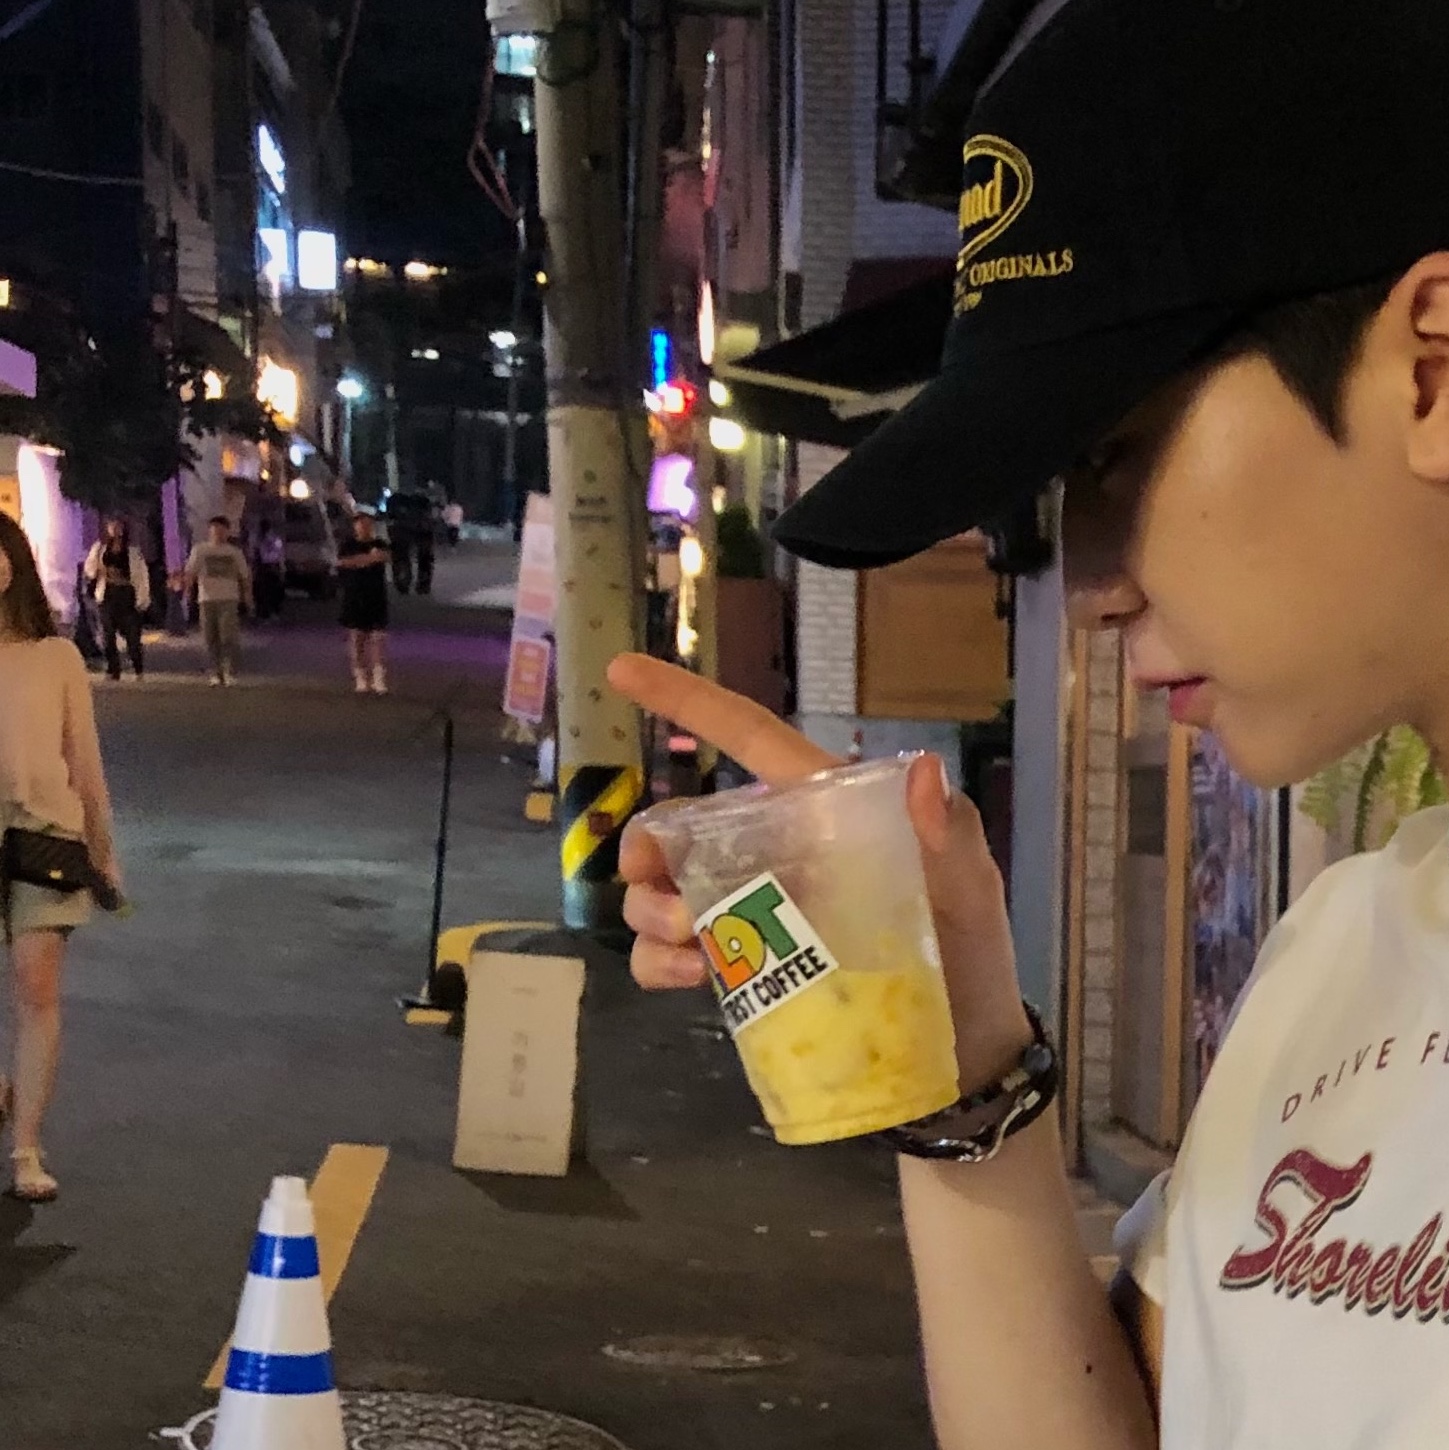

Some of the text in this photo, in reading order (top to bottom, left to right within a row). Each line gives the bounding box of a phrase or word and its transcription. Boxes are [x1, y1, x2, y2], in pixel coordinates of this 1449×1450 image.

[969, 248, 1074, 287] ORIGINALS
[699, 881, 799, 993] LOT
[752, 946, 829, 1007] COFFEE
[1280, 1036, 1396, 1123] DRIVE
